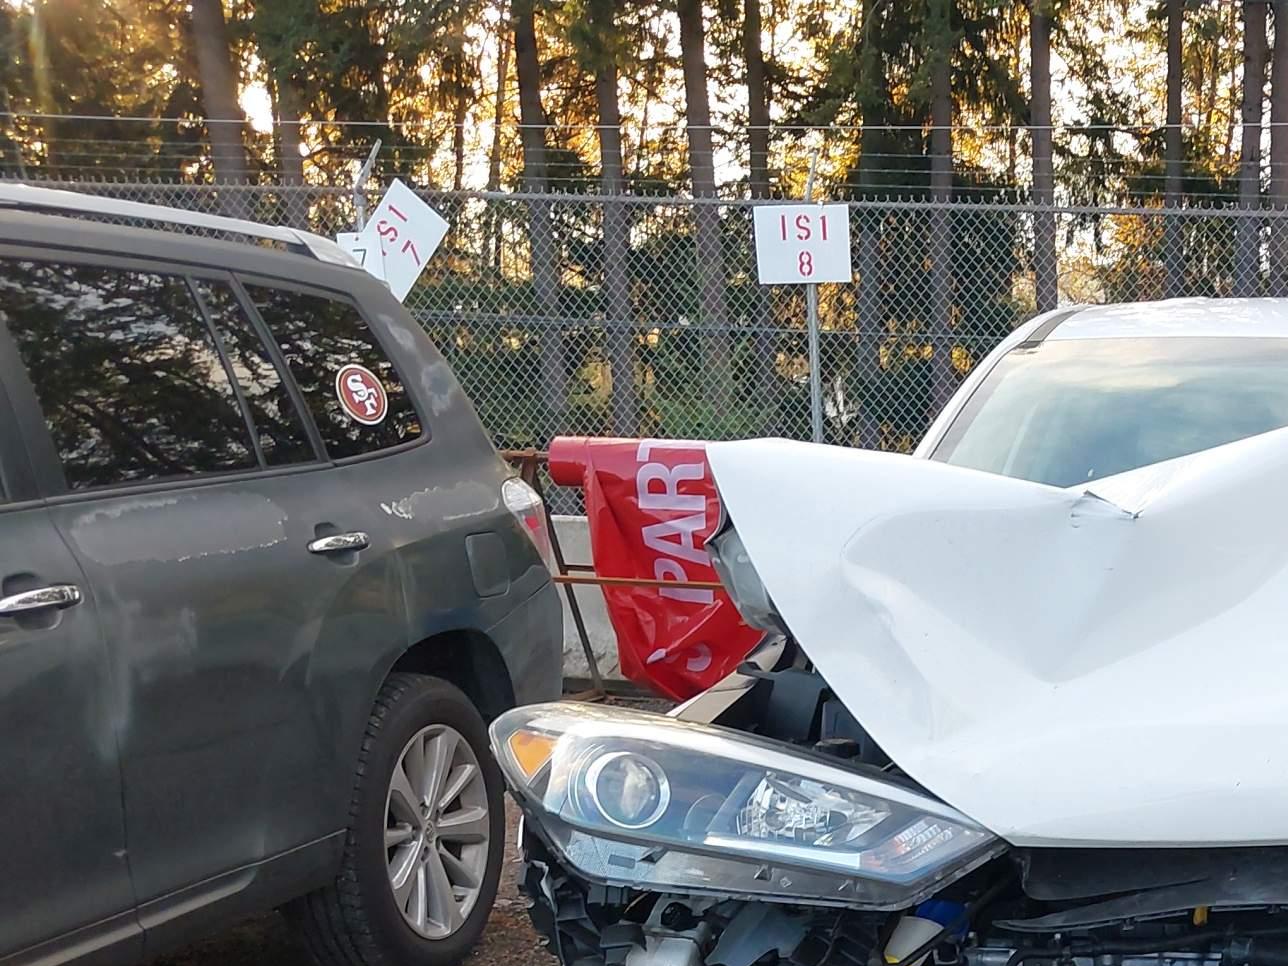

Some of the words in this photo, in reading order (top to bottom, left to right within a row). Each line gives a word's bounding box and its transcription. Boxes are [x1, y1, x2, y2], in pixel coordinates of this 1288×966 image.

[781, 214, 828, 241] IS1
[401, 240, 421, 267] 7
[799, 250, 813, 277] 8
